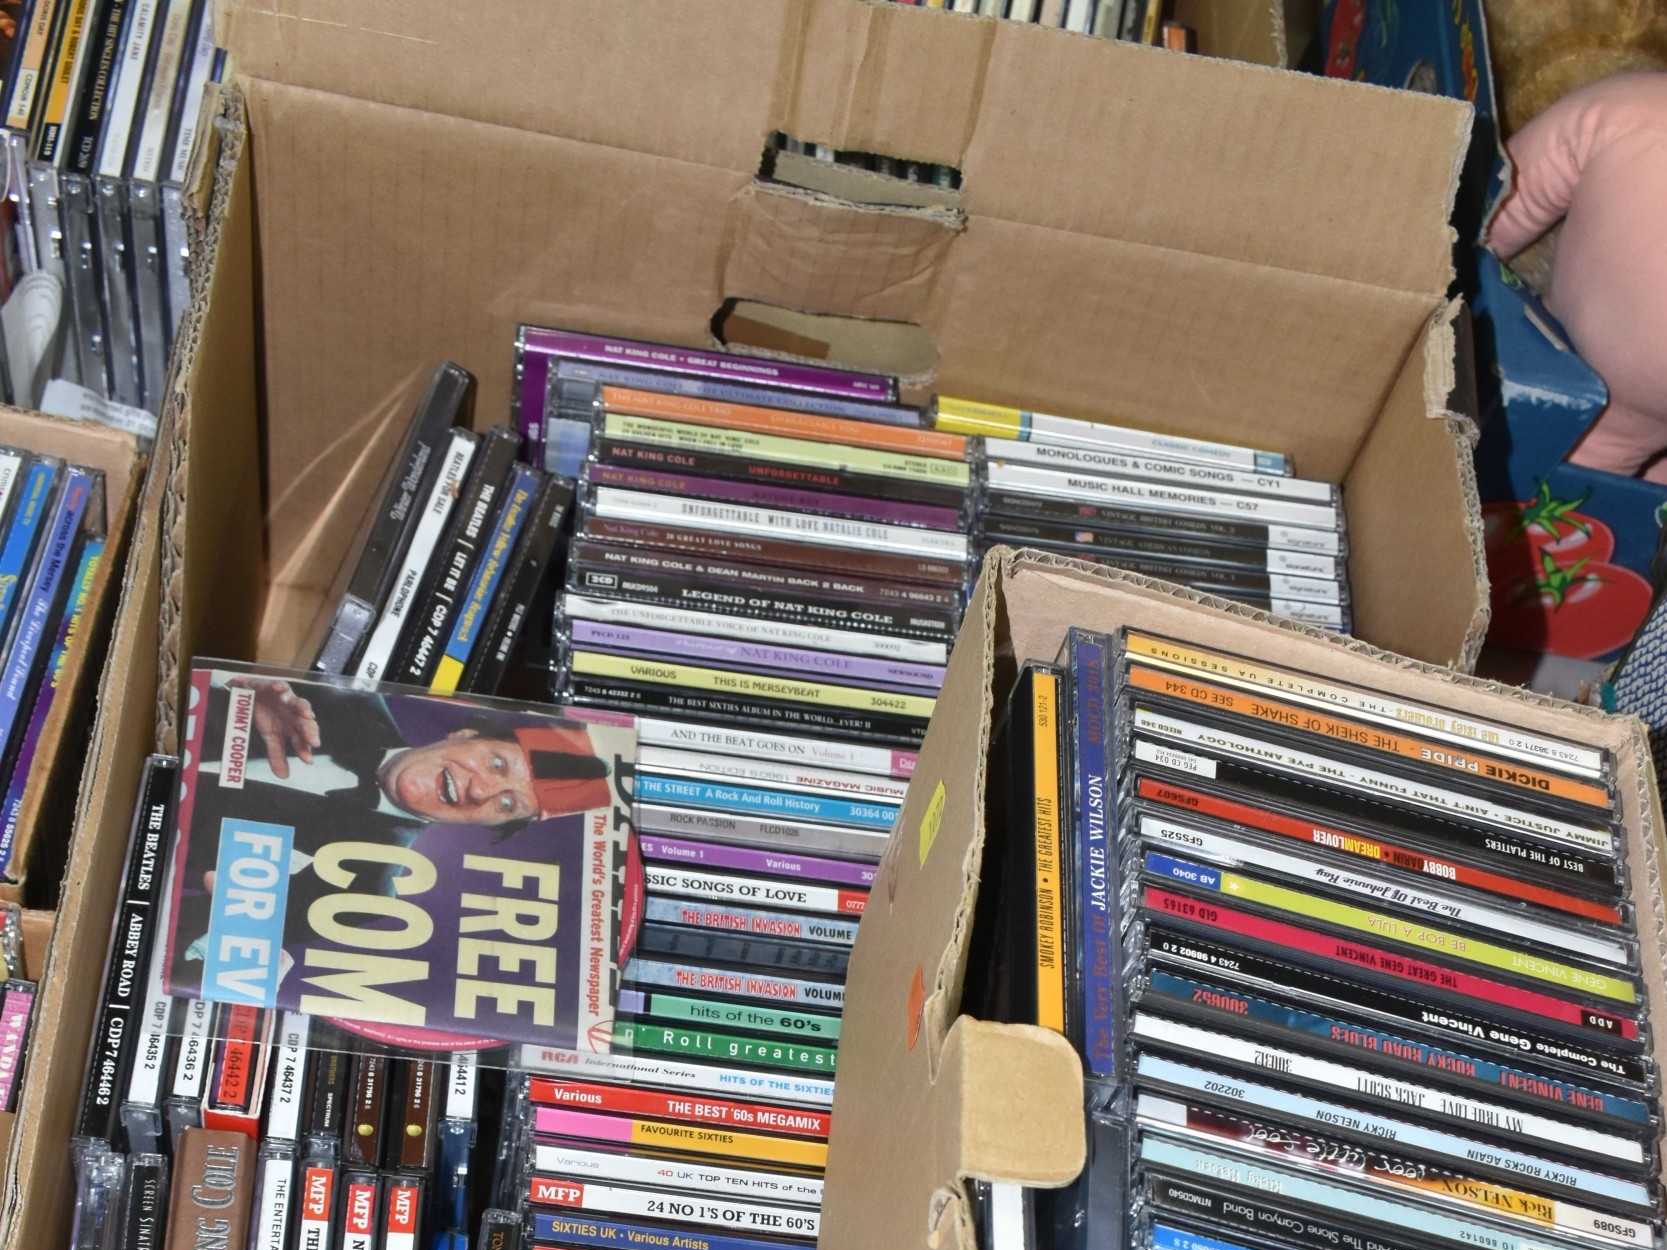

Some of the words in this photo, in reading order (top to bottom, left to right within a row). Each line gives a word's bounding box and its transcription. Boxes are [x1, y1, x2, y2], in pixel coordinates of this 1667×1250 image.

[130, 41, 142, 60] JANE
[605, 344, 623, 356] NAT
[627, 347, 647, 359] KING
[650, 350, 676, 363] COLE
[688, 355, 718, 369] GREAT
[721, 360, 779, 377] BEGINNINGS
[1036, 447, 1127, 469] MONOLOGUES
[1132, 460, 1140, 470] &
[1144, 461, 1185, 476] COMIC
[1190, 467, 1233, 483] SONGS
[1257, 476, 1280, 489] CY1
[479, 485, 495, 503] THE
[1068, 479, 1107, 492] MUSIC
[1113, 484, 1144, 497] HALL
[1149, 489, 1216, 506] MEMORIES
[1236, 499, 1258, 511] C57
[466, 505, 488, 538] BEATLES
[682, 504, 759, 523] UNFORGETTABLE
[768, 514, 791, 527] WITH
[795, 517, 818, 530] LOVE
[822, 521, 859, 535] NATALIE
[864, 526, 888, 539] COLE
[682, 589, 744, 607] LEGEND
[749, 597, 770, 610] OF
[773, 600, 803, 613] NAT
[807, 604, 846, 618] KING
[850, 609, 892, 623] COLE
[714, 676, 737, 688] THIS
[741, 679, 749, 690] IS
[754, 681, 820, 698] MERSEYBEAT
[234, 694, 251, 735] TOMMY
[1251, 701, 1299, 728] SHAKE
[1303, 713, 1320, 733] OF
[671, 729, 696, 741] AND
[700, 732, 722, 744] THE
[726, 735, 755, 748] BEAT
[757, 739, 785, 751] GOES
[788, 742, 805, 754] ON
[1324, 717, 1367, 743] SHEIK
[1369, 727, 1401, 751] THE
[227, 740, 245, 784] COOPER
[1421, 747, 1478, 774] PRIDE
[1486, 761, 1550, 791] DICKIE
[644, 780, 662, 793] THE
[665, 782, 700, 797] STREET
[706, 787, 712, 799] A
[716, 788, 738, 802] Rock
[742, 791, 762, 804] And
[764, 794, 782, 807] Roll
[785, 797, 819, 811] History
[1038, 797, 1052, 816] HITS
[1088, 775, 1104, 839] WILSON
[148, 804, 165, 828] THE
[593, 815, 606, 833] The
[1039, 818, 1052, 855] GREATEST
[136, 833, 159, 890] BEATLES
[224, 830, 281, 920] FOR
[1039, 857, 1053, 872] THE
[682, 878, 734, 895] SONGS
[739, 884, 760, 898] OF
[764, 887, 806, 902] LOVE
[1090, 847, 1106, 910] JACKIE
[588, 891, 604, 943] Greatest
[682, 910, 701, 925] THE
[704, 912, 747, 930] BRITISH
[752, 917, 801, 936] INVASION
[1039, 888, 1054, 933] ROBINSON
[124, 913, 144, 957] ABBEY
[300, 841, 438, 1026] COM
[454, 854, 560, 1027] FREE
[809, 925, 852, 940] VOLUME
[1039, 936, 1054, 969] SMOKEY
[116, 960, 136, 997] ROAD
[215, 939, 271, 1001] EV
[585, 948, 602, 1016] Newspaper
[691, 1005, 720, 1020] hits
[726, 1008, 742, 1022] of
[747, 1011, 774, 1026] the
[1422, 1012, 1483, 1038] Vincent
[664, 1031, 712, 1050] Roll
[730, 1040, 835, 1065] greatest
[1490, 1029, 1531, 1050] Gene
[1537, 1041, 1596, 1067] Complete
[1601, 1057, 1624, 1074] The
[554, 1088, 602, 1104] Various
[667, 1100, 692, 1116] THE
[695, 1104, 727, 1120] BEST
[757, 1111, 820, 1130] MEGAMIX
[1467, 1150, 1501, 1166] AGAIN
[1505, 1158, 1541, 1176] ROCKS
[275, 1178, 287, 1198] THE
[1544, 1167, 1576, 1185] RICKY
[537, 1185, 580, 1202] MFP
[1441, 1179, 1512, 1209] NELSON
[1517, 1194, 1552, 1218] Rick
[647, 1200, 664, 1214] 24
[668, 1203, 694, 1217] NO
[723, 1209, 745, 1223] OF
[750, 1212, 781, 1227] THE
[552, 1221, 596, 1238] SIXTIES
[600, 1227, 616, 1240] UK
[628, 1230, 669, 1246] Various
[672, 1235, 708, 1250] Artists
